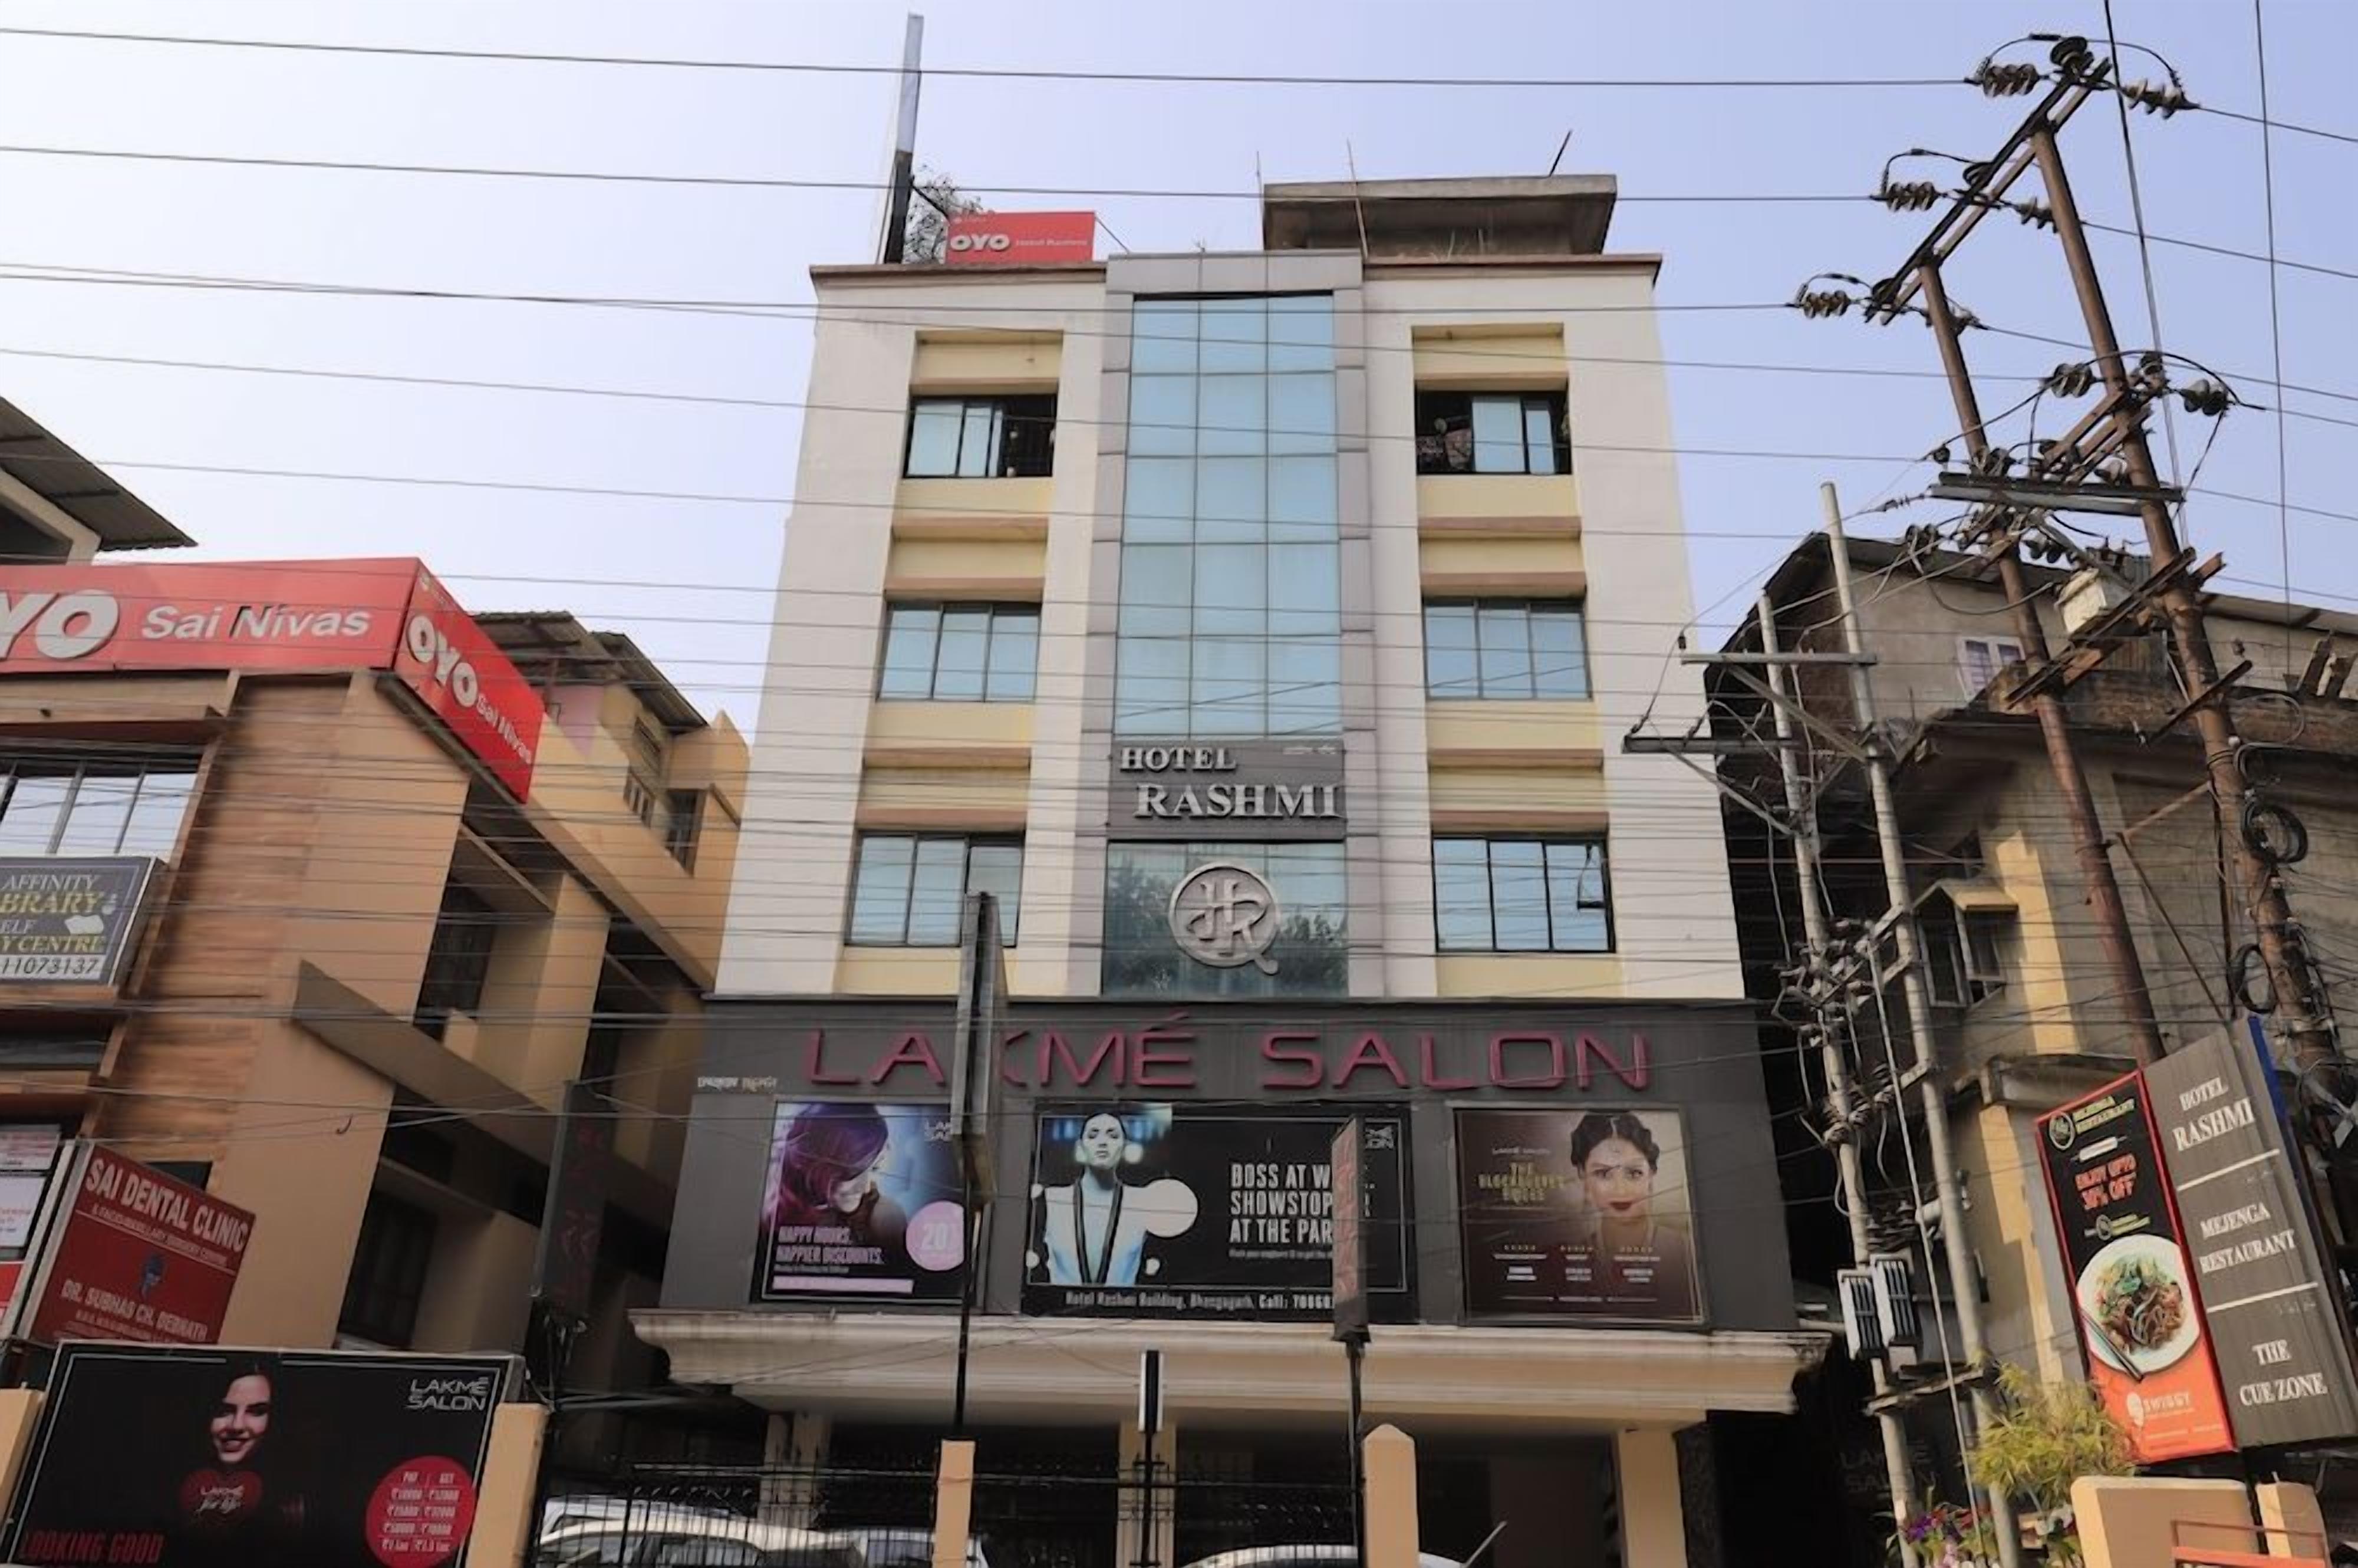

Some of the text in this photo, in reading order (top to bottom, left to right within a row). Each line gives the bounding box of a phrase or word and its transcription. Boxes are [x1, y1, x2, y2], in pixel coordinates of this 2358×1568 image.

[950, 233, 1010, 252] OYO
[141, 605, 223, 639] Sai
[231, 603, 373, 639] Nivas
[408, 615, 478, 708] OYO
[477, 693, 498, 727] Sai
[1120, 747, 1238, 773] HOTEL
[1134, 782, 1343, 819] RASHMI
[1, 874, 101, 891] AFFINITY
[1262, 1032, 1648, 1090] SALON
[2180, 1077, 2229, 1112] HOTEL
[2172, 1097, 2255, 1152] RASHMI
[1231, 1163, 1279, 1189] BOSS
[1285, 1164, 1307, 1189] AT
[85, 1158, 123, 1200] SAI
[120, 1174, 190, 1231] DENTAL
[193, 1205, 248, 1253] CLINIC
[1230, 1190, 1332, 1215] SHOWSTOP
[1229, 1218, 1333, 1244] AT THE PAR
[2200, 1202, 2271, 1239] MEJENGA
[2199, 1228, 2297, 1274] RESTAURANT
[2251, 1339, 2291, 1365] THE
[407, 1395, 486, 1410] SALON
[2240, 1372, 2328, 1406] CUE ZONE
[107, 1533, 166, 1564] GOOD
